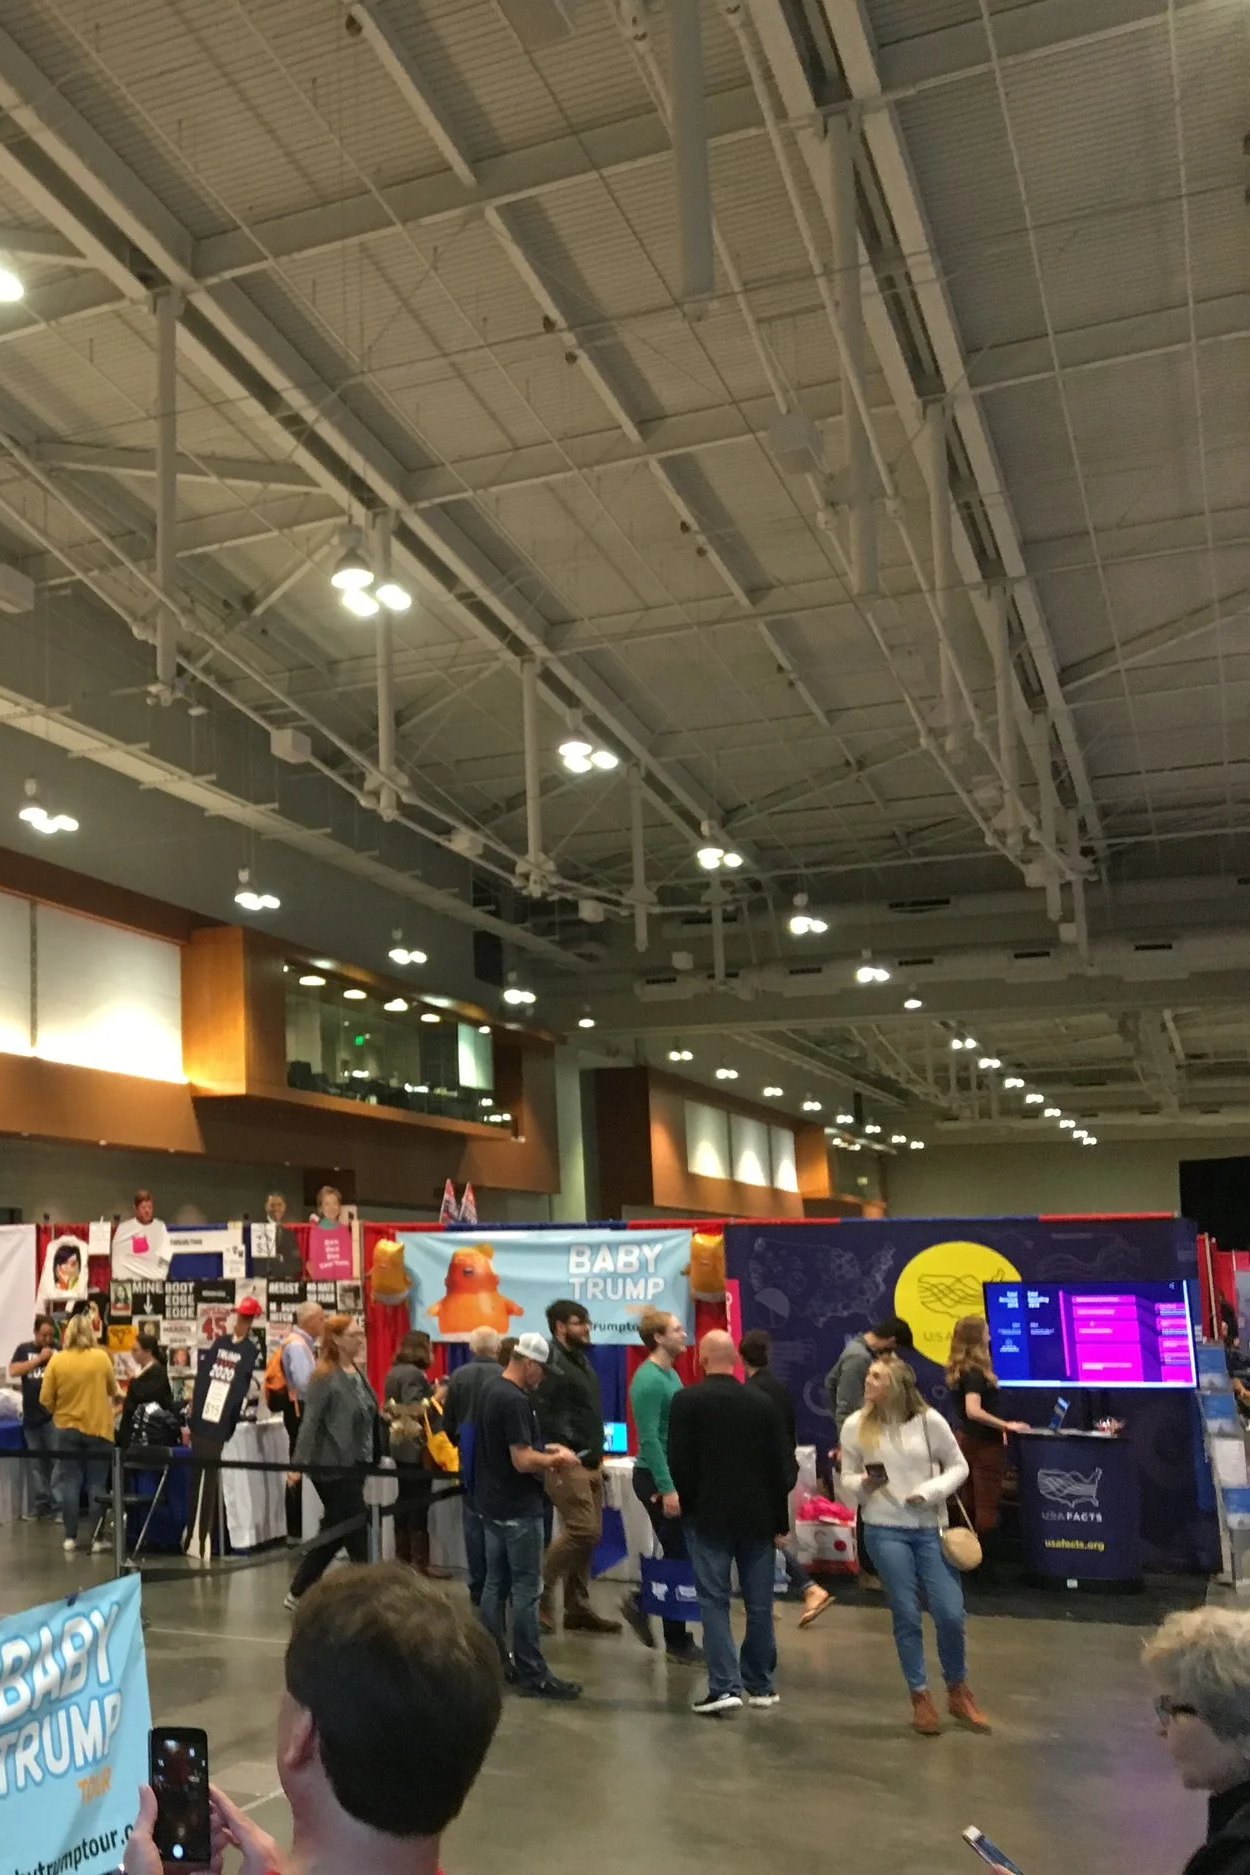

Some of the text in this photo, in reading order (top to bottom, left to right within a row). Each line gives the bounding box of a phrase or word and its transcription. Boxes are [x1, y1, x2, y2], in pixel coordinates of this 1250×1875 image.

[568, 1243, 663, 1274] BABY
[568, 1277, 665, 1300] TRUMP
[209, 1363, 235, 1380] 2020
[77, 1765, 111, 1804] TOUR
